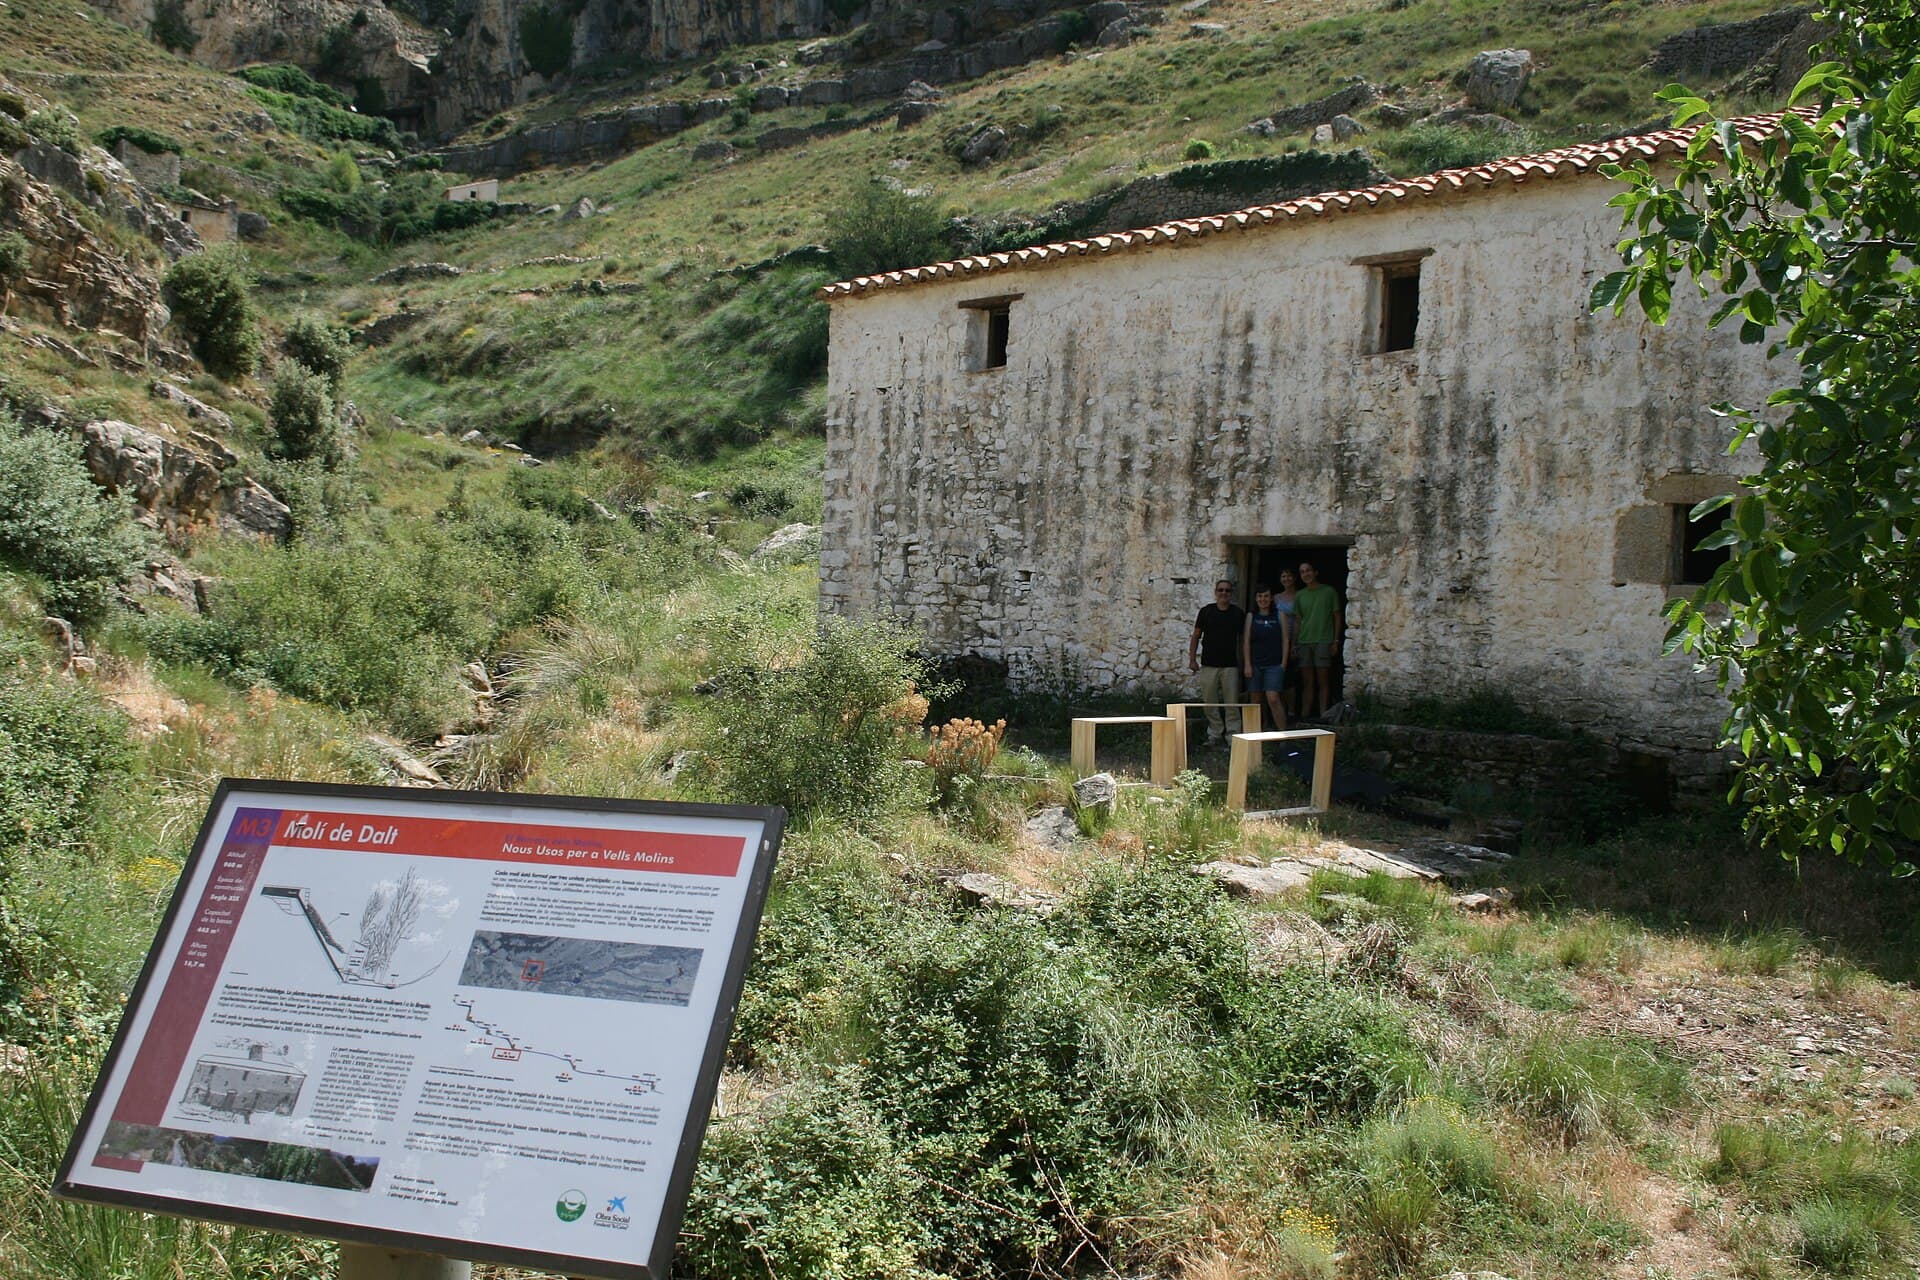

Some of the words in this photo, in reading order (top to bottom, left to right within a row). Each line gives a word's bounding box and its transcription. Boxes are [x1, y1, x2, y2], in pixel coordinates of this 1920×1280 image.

[236, 817, 272, 837] M3
[283, 820, 328, 840] Molí
[329, 822, 353, 842] de
[357, 825, 399, 845] Dalt
[502, 843, 532, 855] Nous
[536, 845, 564, 857] Usos
[566, 848, 589, 860] per
[591, 850, 599, 860] a
[602, 849, 631, 862] Vells
[634, 852, 674, 865] Molins
[594, 1212, 611, 1221] Obra
[611, 1214, 630, 1223] Social
